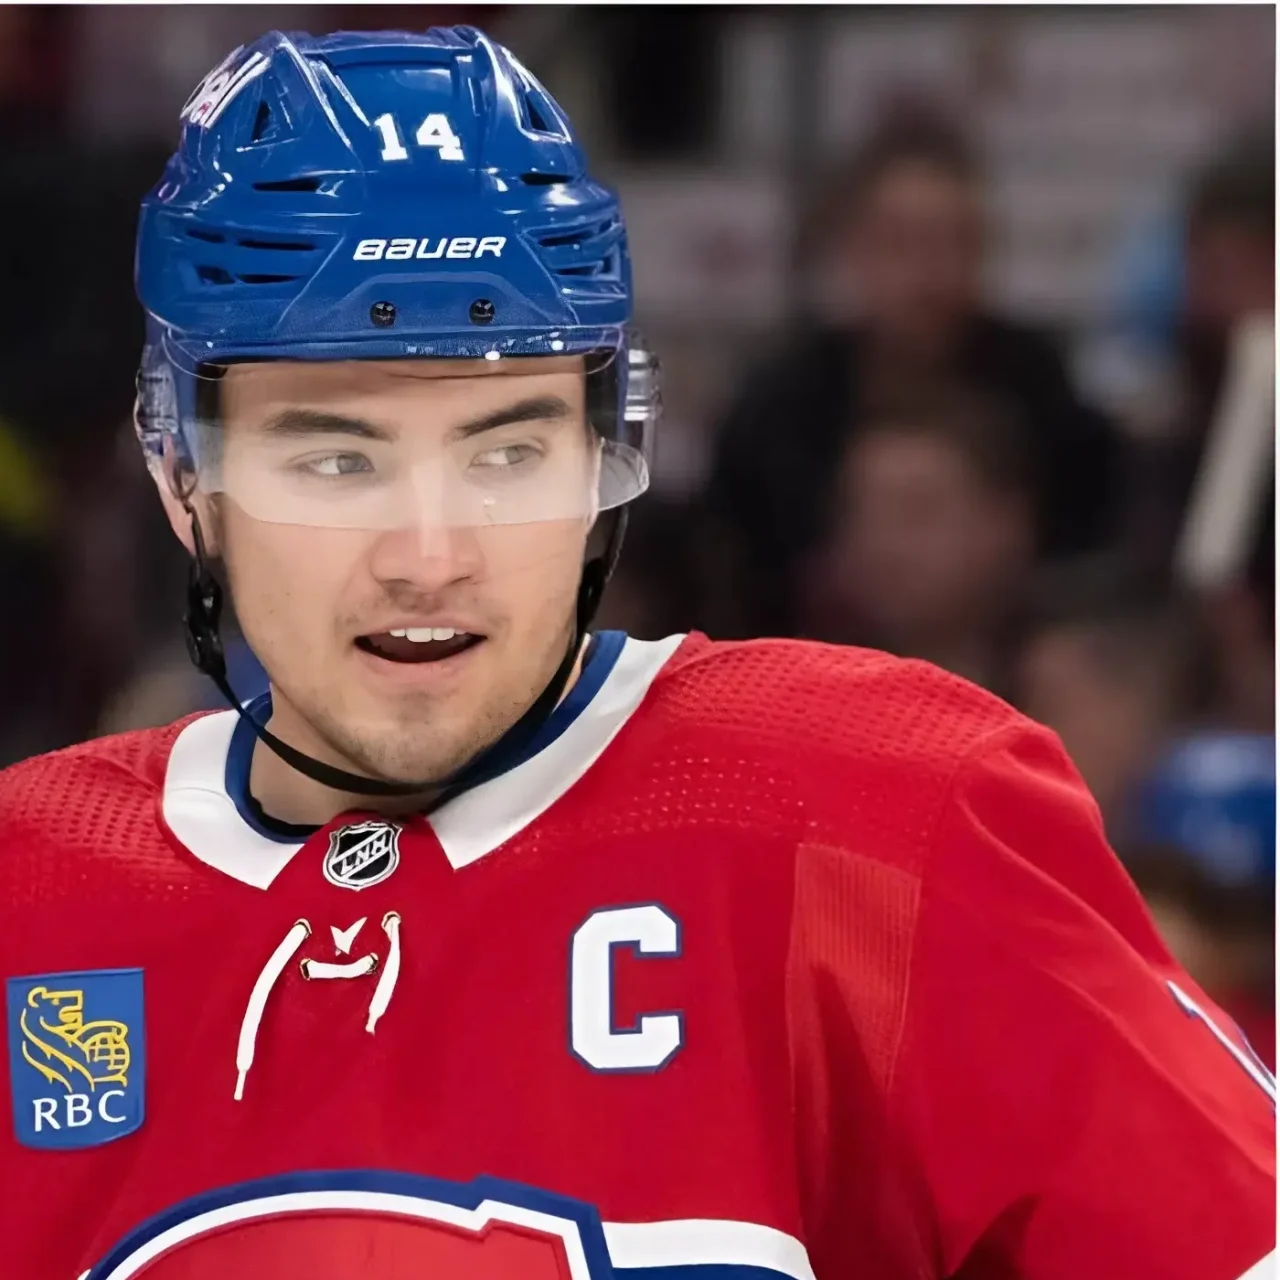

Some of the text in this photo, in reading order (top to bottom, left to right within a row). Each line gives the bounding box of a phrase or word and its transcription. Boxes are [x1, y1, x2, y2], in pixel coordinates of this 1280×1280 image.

[373, 112, 465, 162] 14
[352, 236, 507, 262] BAUER
[571, 904, 682, 1071] C
[32, 1089, 128, 1132] RBC
